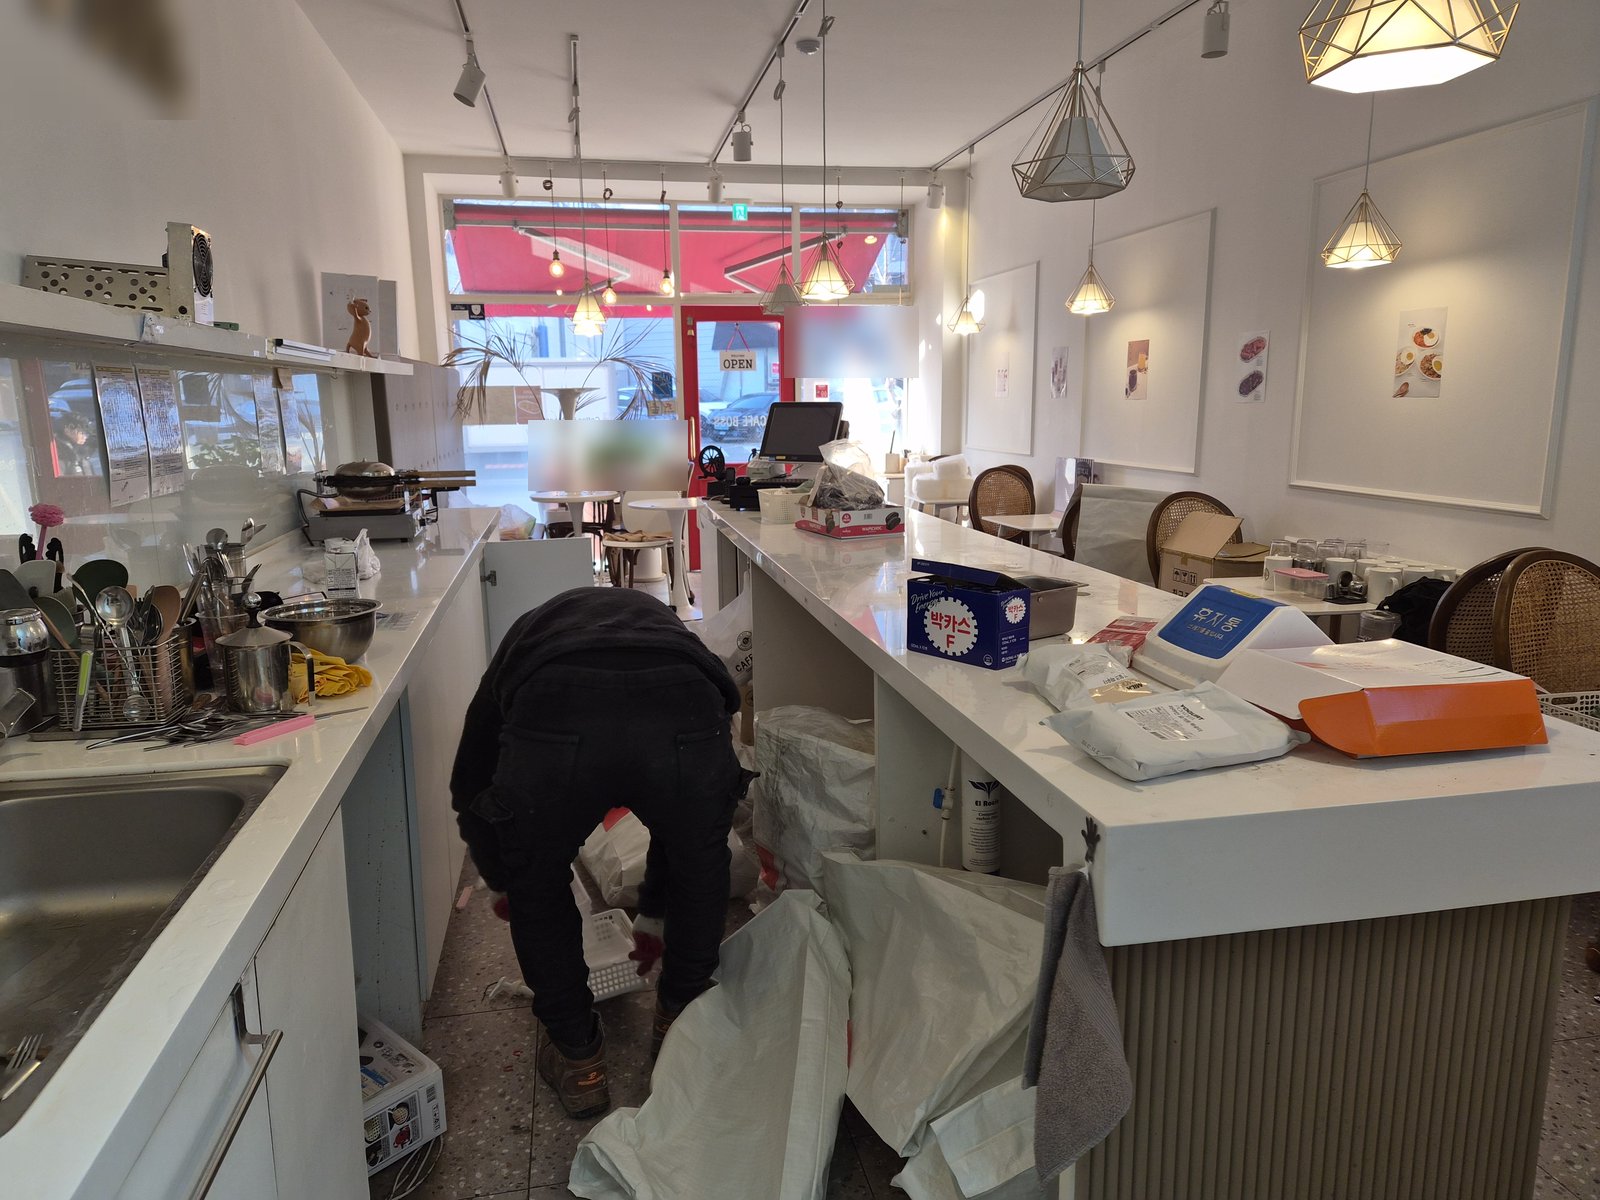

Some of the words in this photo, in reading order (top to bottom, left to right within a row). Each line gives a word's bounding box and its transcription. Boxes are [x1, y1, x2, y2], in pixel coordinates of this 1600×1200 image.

[723, 359, 753, 369] OPEN
[910, 592, 929, 605] Drive
[929, 589, 944, 600] Your
[1007, 604, 1024, 613] 박카스
[931, 611, 971, 635] 박카스
[1192, 607, 1243, 632] 휴지통
[946, 634, 956, 648] F
